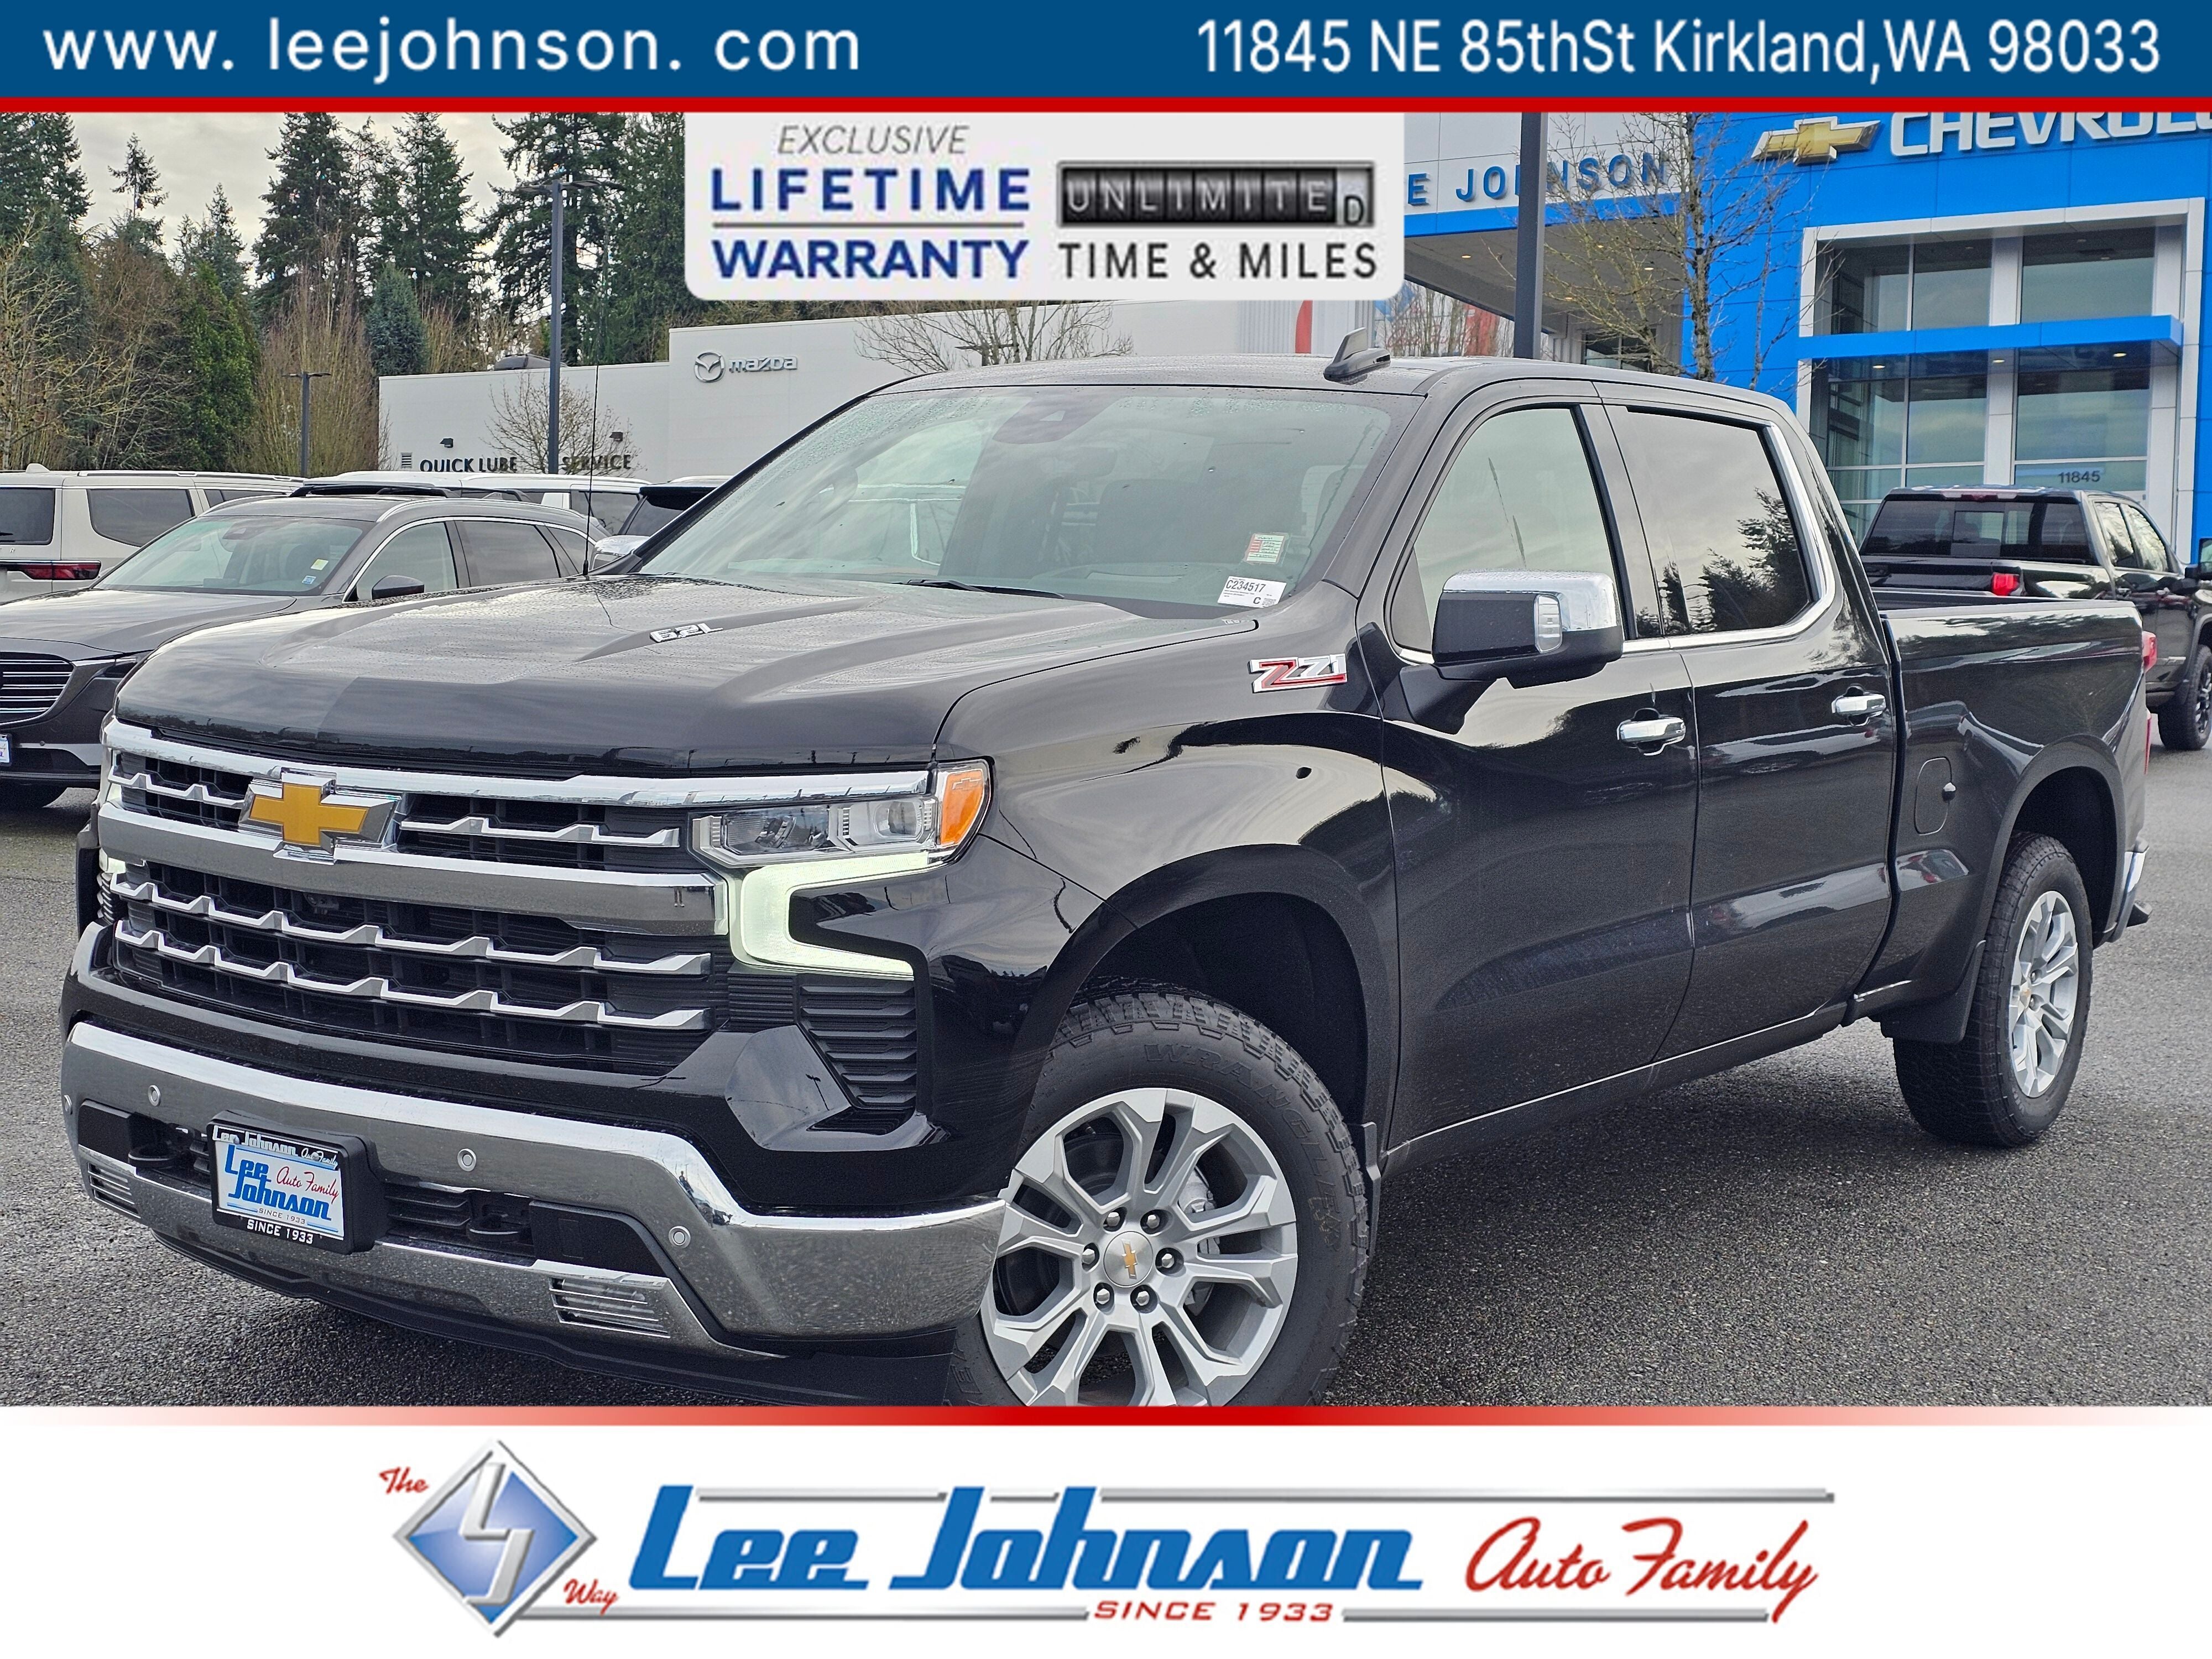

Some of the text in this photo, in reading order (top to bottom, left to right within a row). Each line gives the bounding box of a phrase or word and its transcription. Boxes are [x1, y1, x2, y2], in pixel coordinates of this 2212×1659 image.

[728, 356, 797, 373] mazda
[420, 457, 518, 473] QUICK LUBE
[562, 455, 632, 471] SERVICE
[2058, 470, 2101, 484] 11845
[1226, 580, 1266, 593] C234517
[1248, 654, 1348, 693] Z71
[225, 1144, 340, 1205] Lee Auto Family
[228, 1173, 332, 1221] Johnson
[258, 1208, 306, 1224] SINCE 1933
[247, 1219, 314, 1244] SINCE 1933
